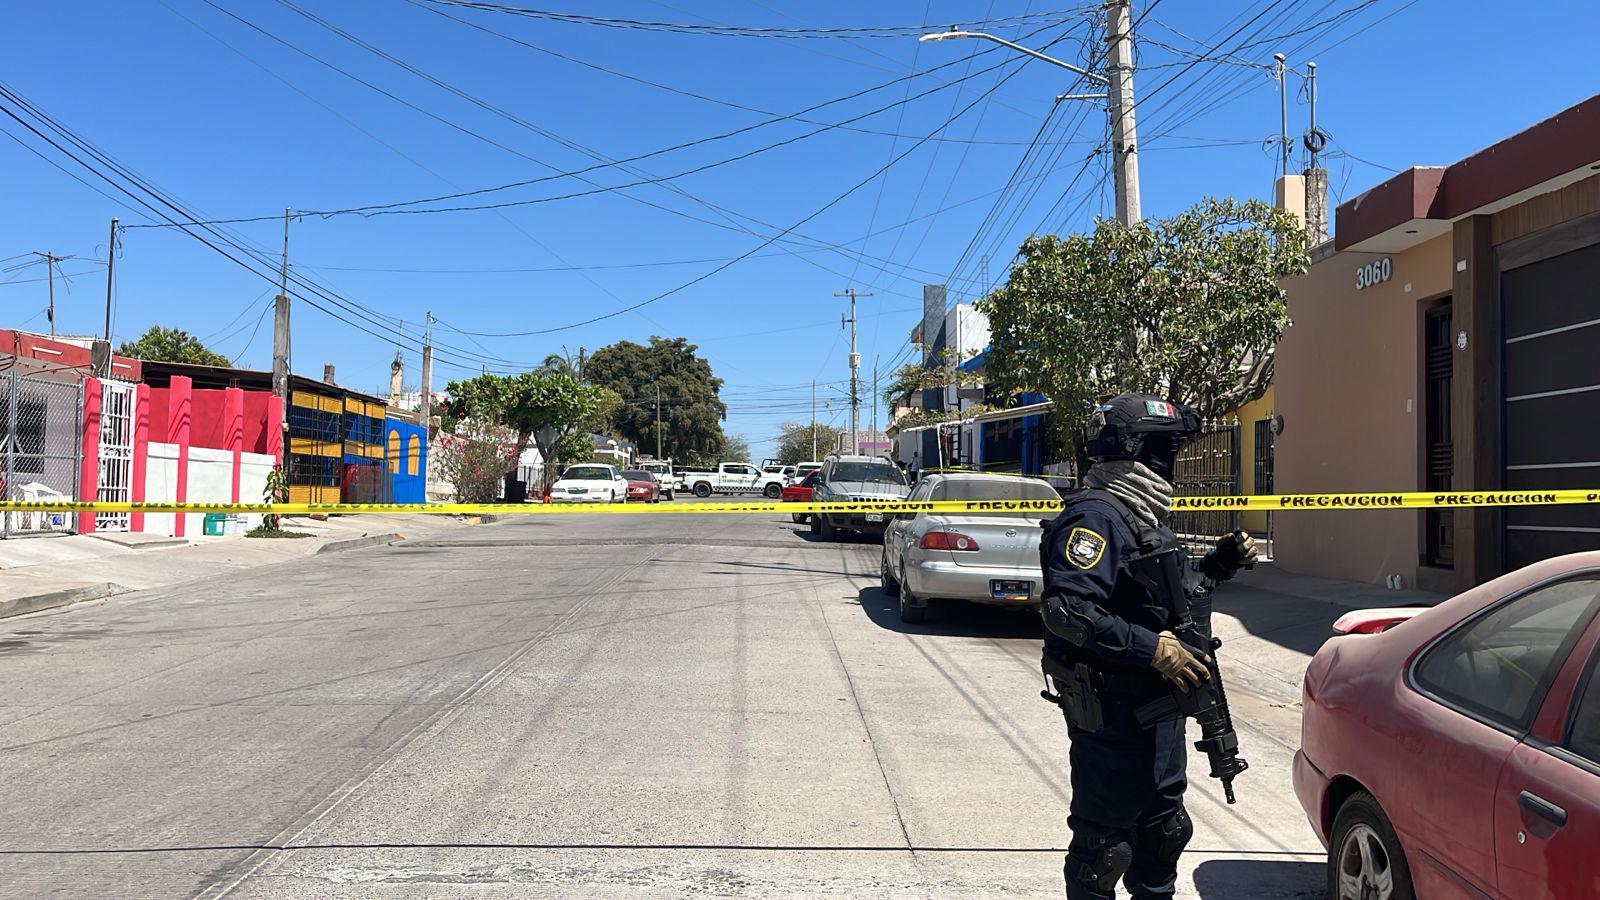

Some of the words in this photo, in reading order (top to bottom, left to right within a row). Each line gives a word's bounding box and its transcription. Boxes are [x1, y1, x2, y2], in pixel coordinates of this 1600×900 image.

[1356, 257, 1390, 290] 3060
[1171, 497, 1249, 507] AUCION
[1280, 496, 1403, 507] PRECAUCION
[1434, 494, 1557, 505] PRECAUCION
[1586, 493, 1600, 502] P
